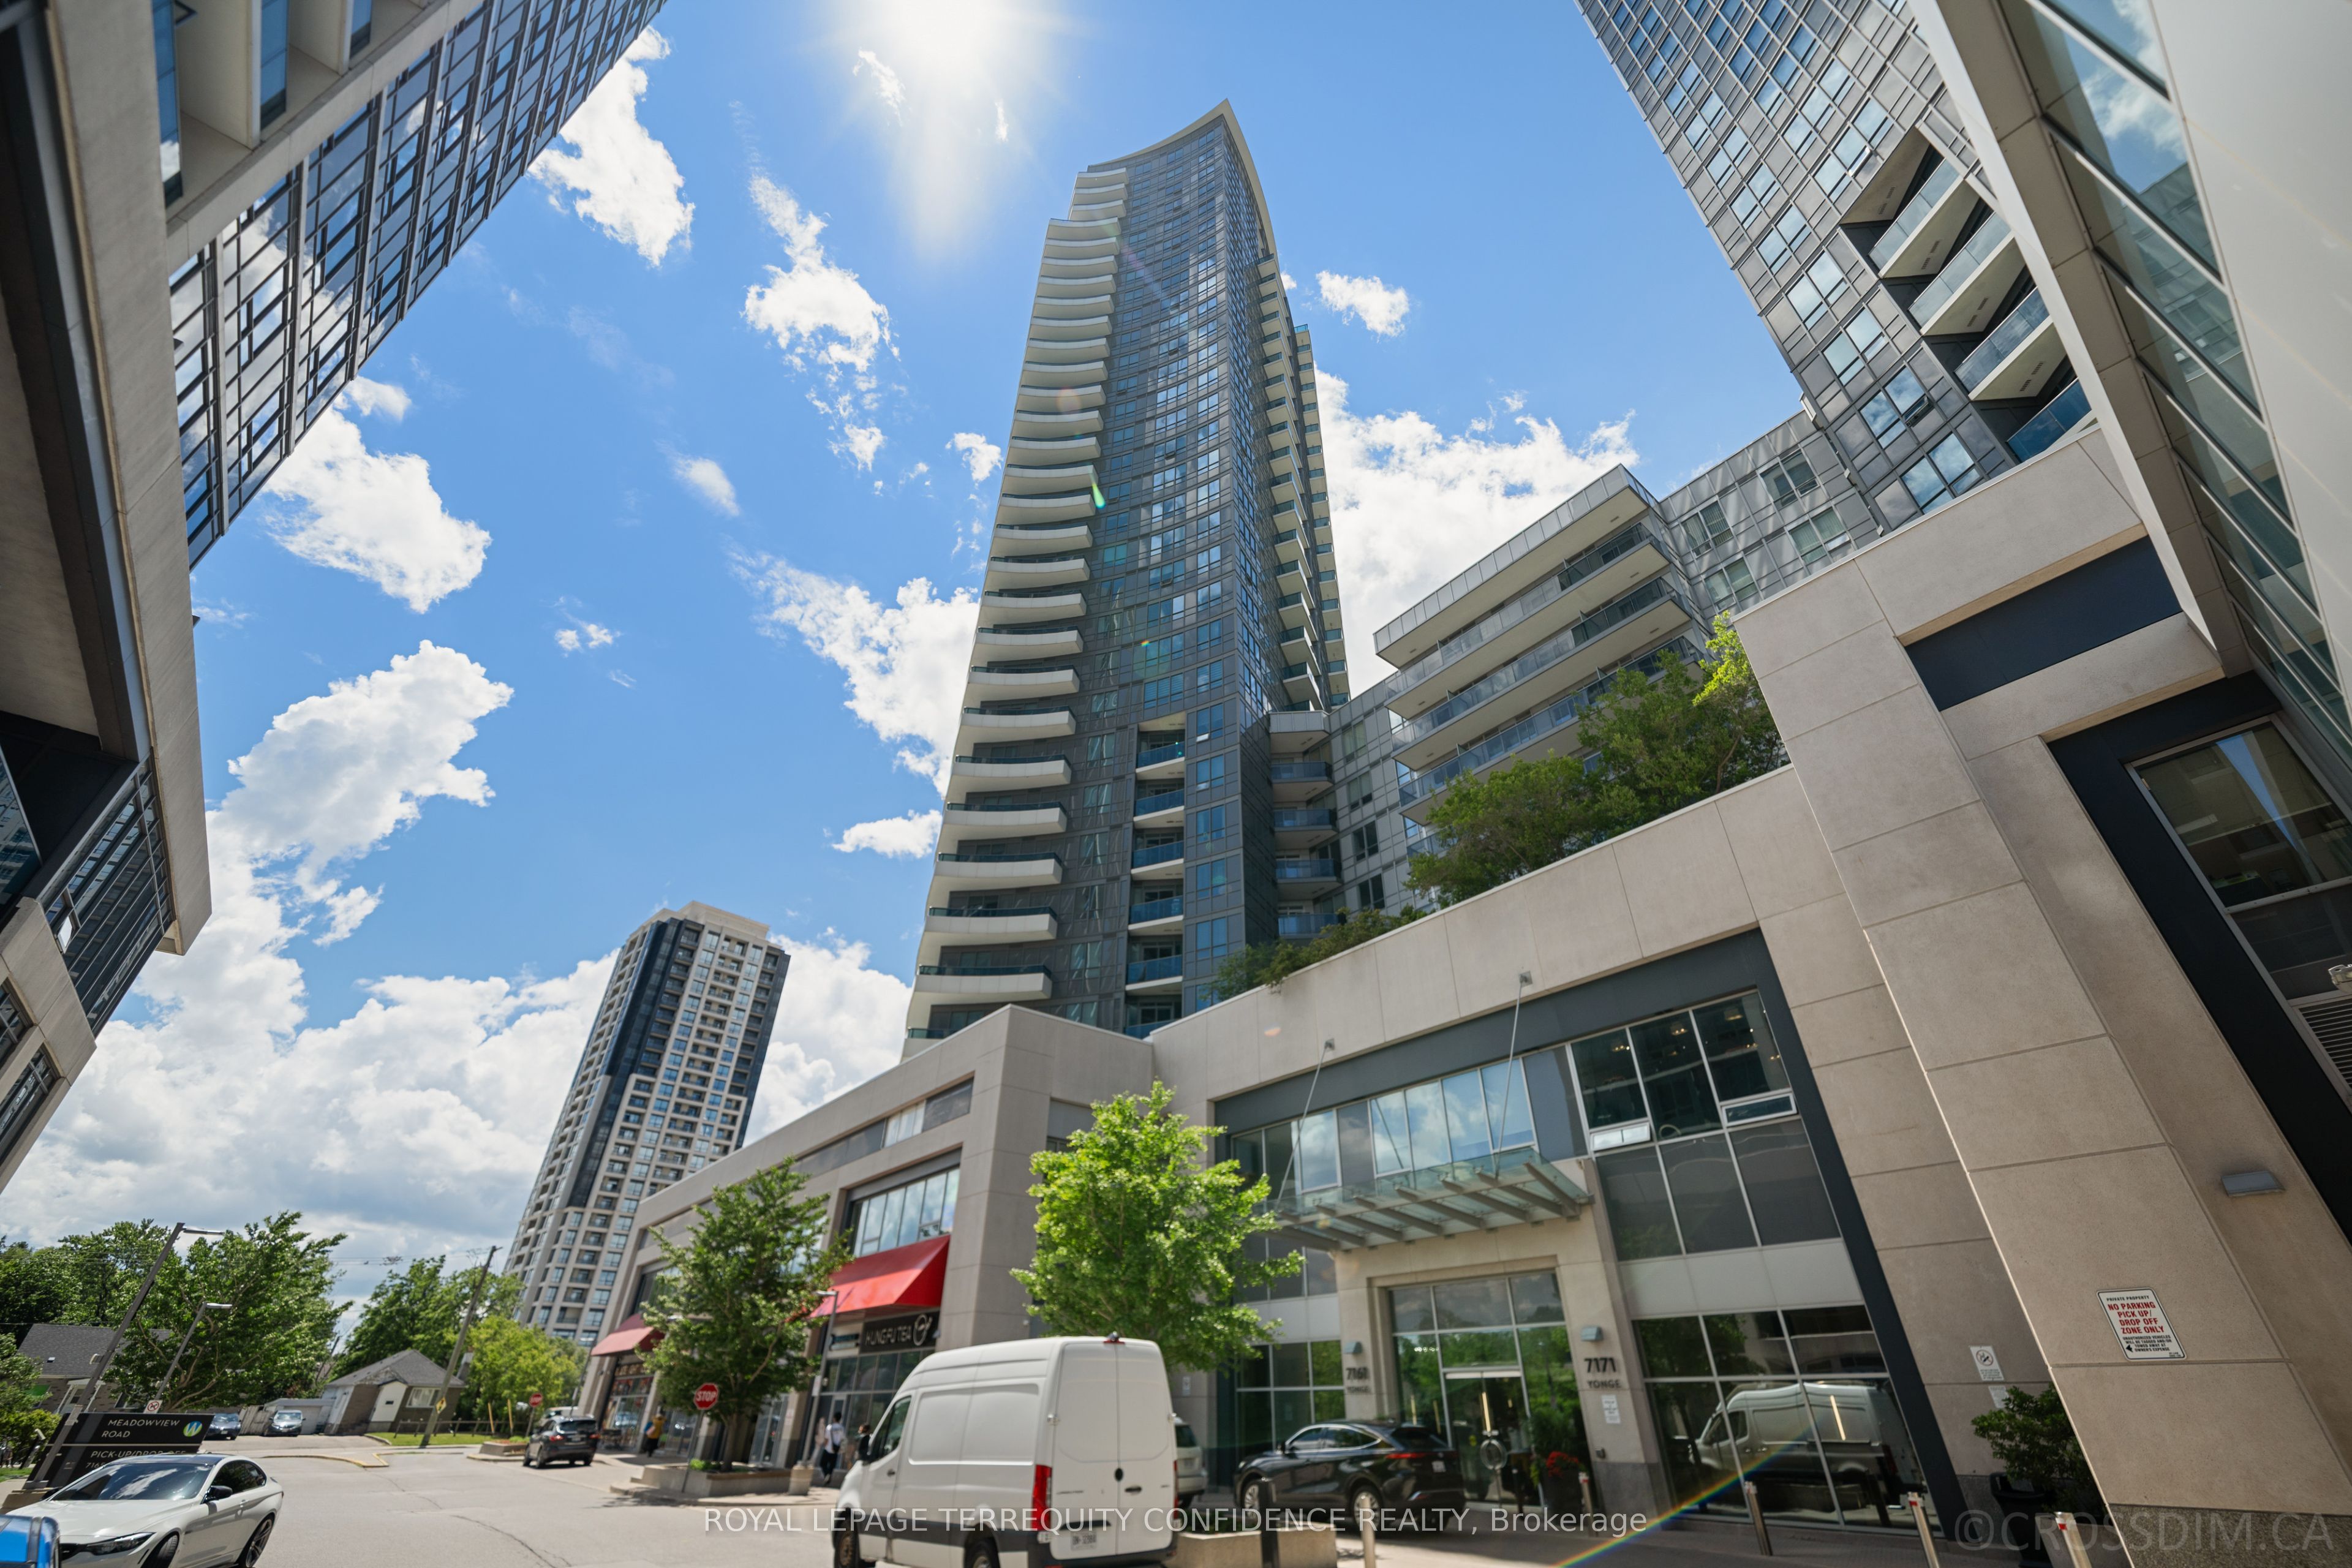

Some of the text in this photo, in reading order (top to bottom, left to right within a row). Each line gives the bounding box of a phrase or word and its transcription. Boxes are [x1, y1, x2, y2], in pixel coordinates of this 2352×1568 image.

[1584, 1357, 1616, 1373] 7171
[1587, 1379, 1622, 1389] YONGE
[696, 1390, 716, 1401] STOP
